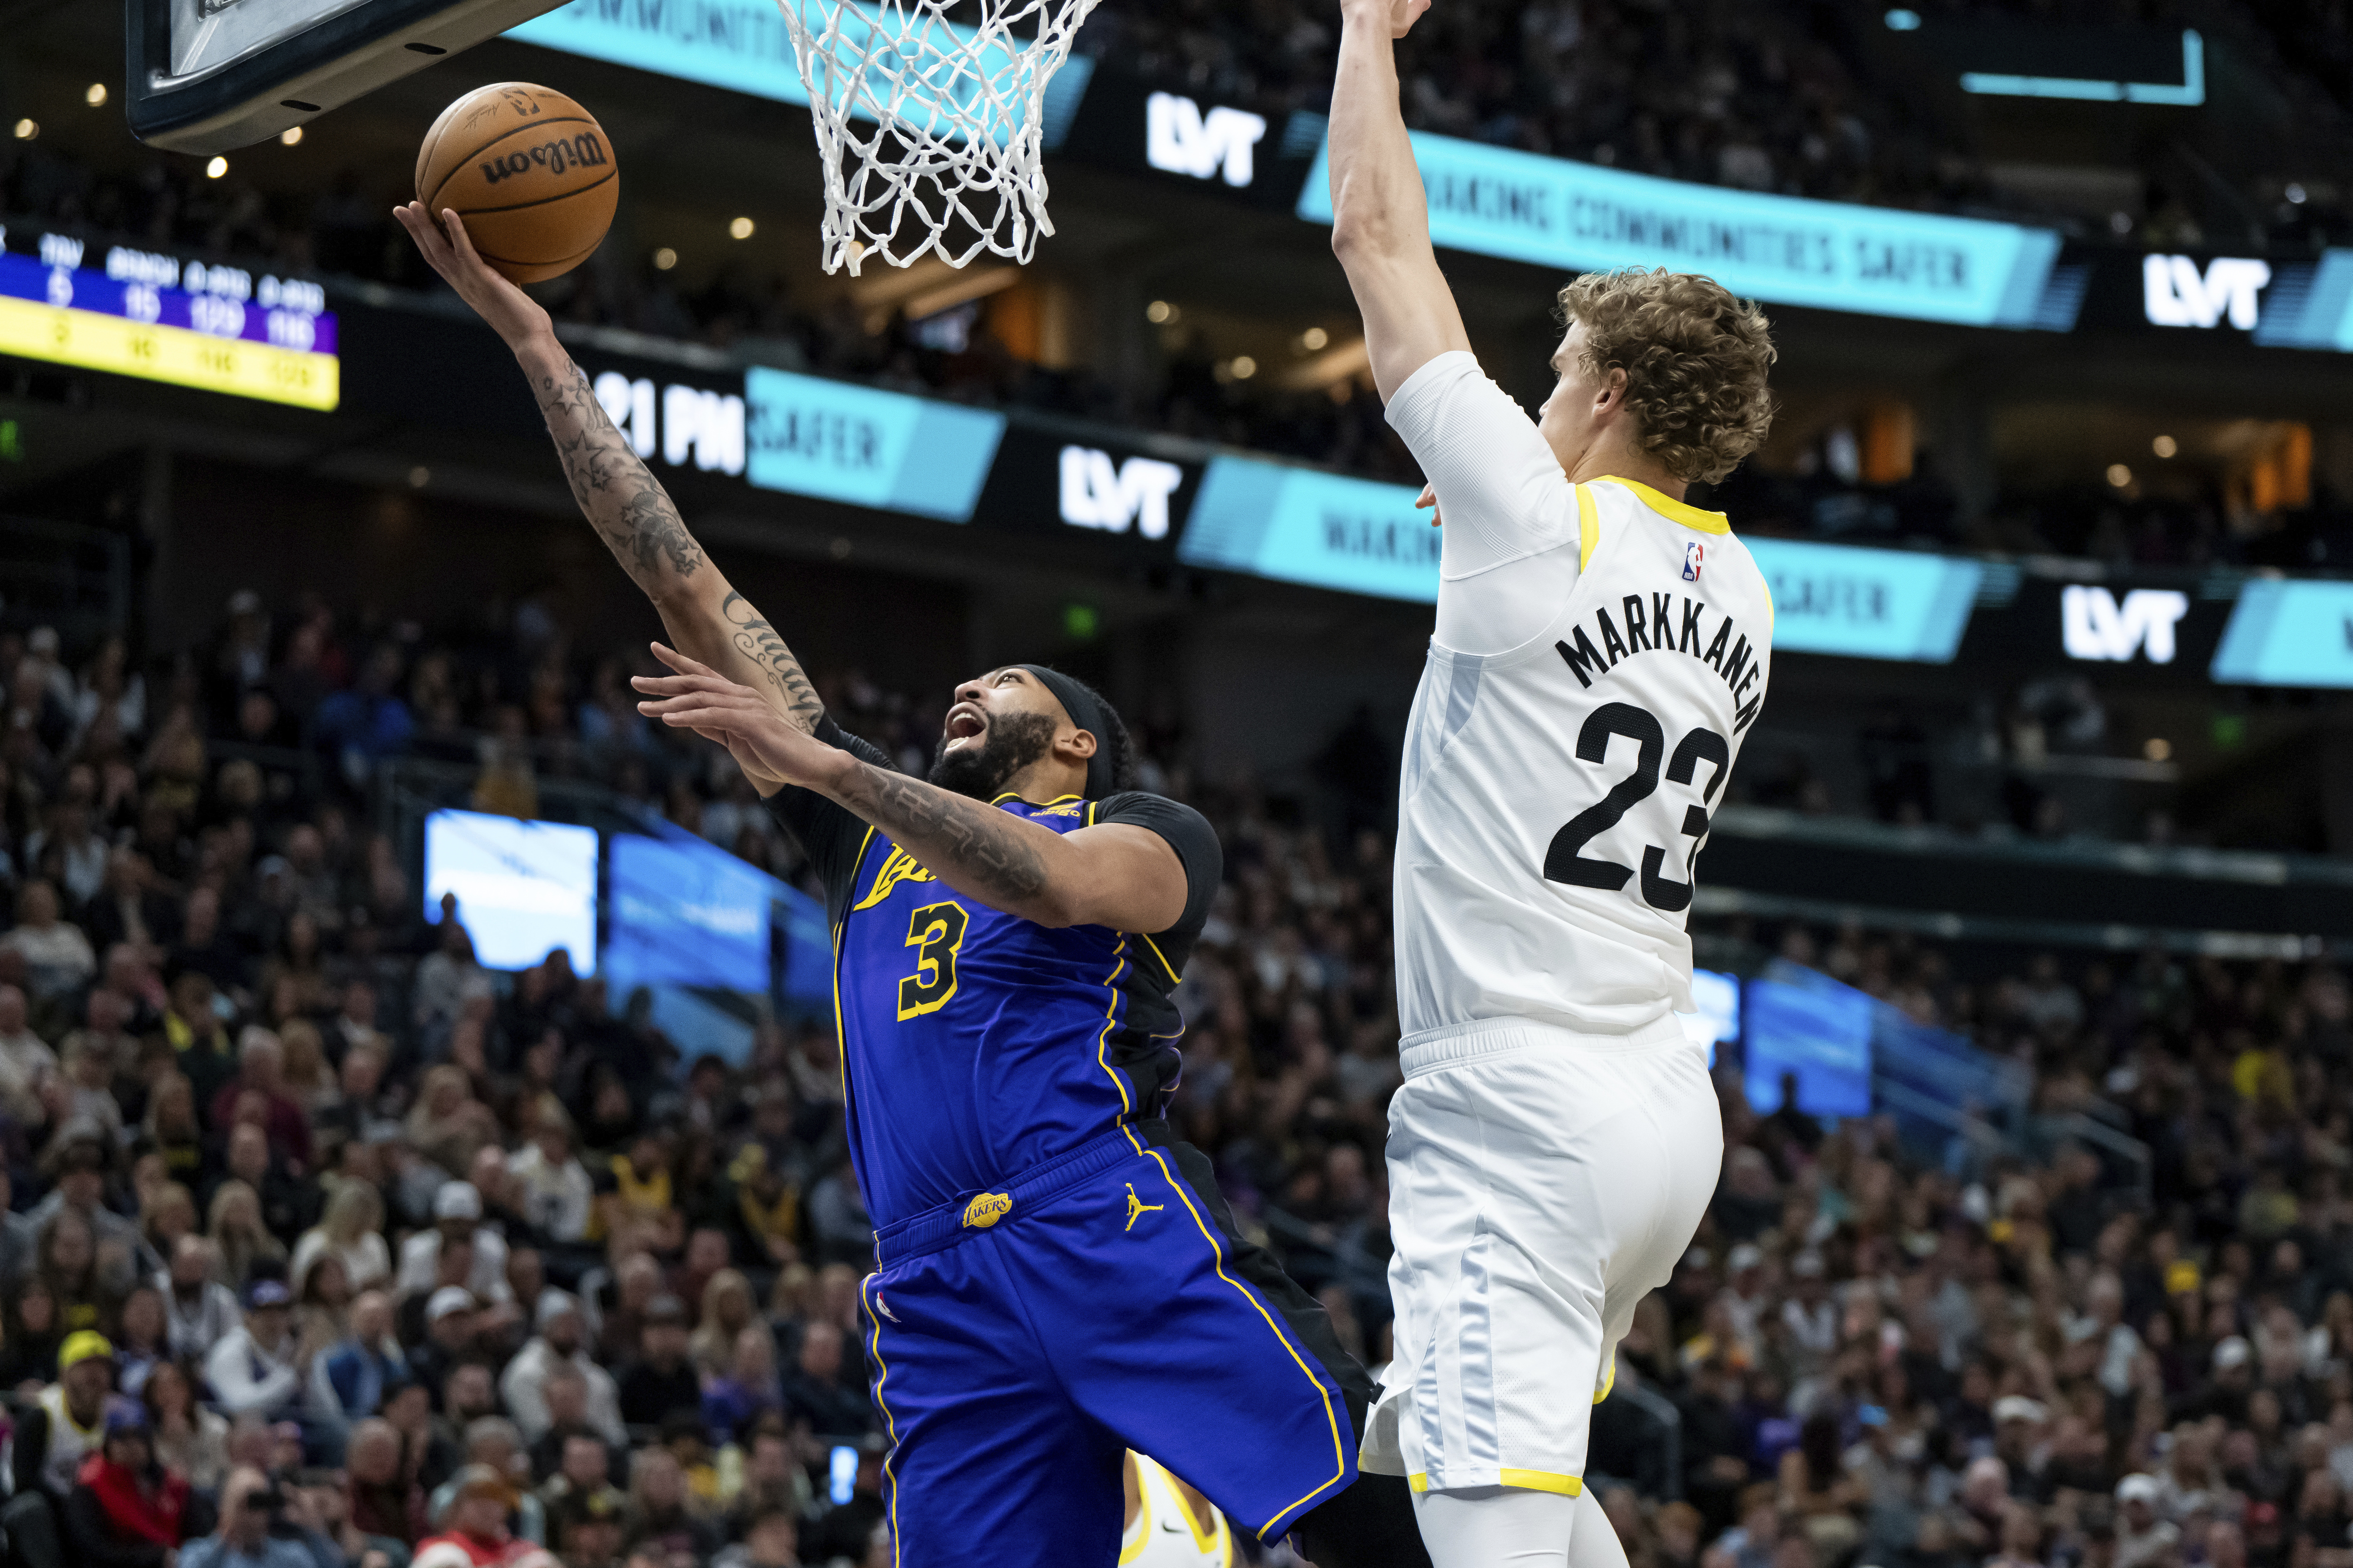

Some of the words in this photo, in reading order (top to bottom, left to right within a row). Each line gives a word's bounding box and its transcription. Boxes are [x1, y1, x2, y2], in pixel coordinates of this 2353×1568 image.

[479, 131, 608, 184] Wilson
[1146, 91, 1267, 187] LVT
[1852, 236, 1971, 289] SAFER
[2142, 253, 2271, 330] LVT
[663, 383, 746, 476] PM
[748, 398, 885, 469] SAFER
[1058, 444, 1183, 540] LVT
[1684, 572, 1693, 580] NBA
[2061, 584, 2188, 664] LVT
[1555, 592, 1762, 736] MARKKANEN
[1543, 702, 1730, 912] 23
[897, 900, 969, 1022] 3
[965, 1198, 1007, 1226] LAKERS
[984, 1194, 1006, 1203] ANGELES
